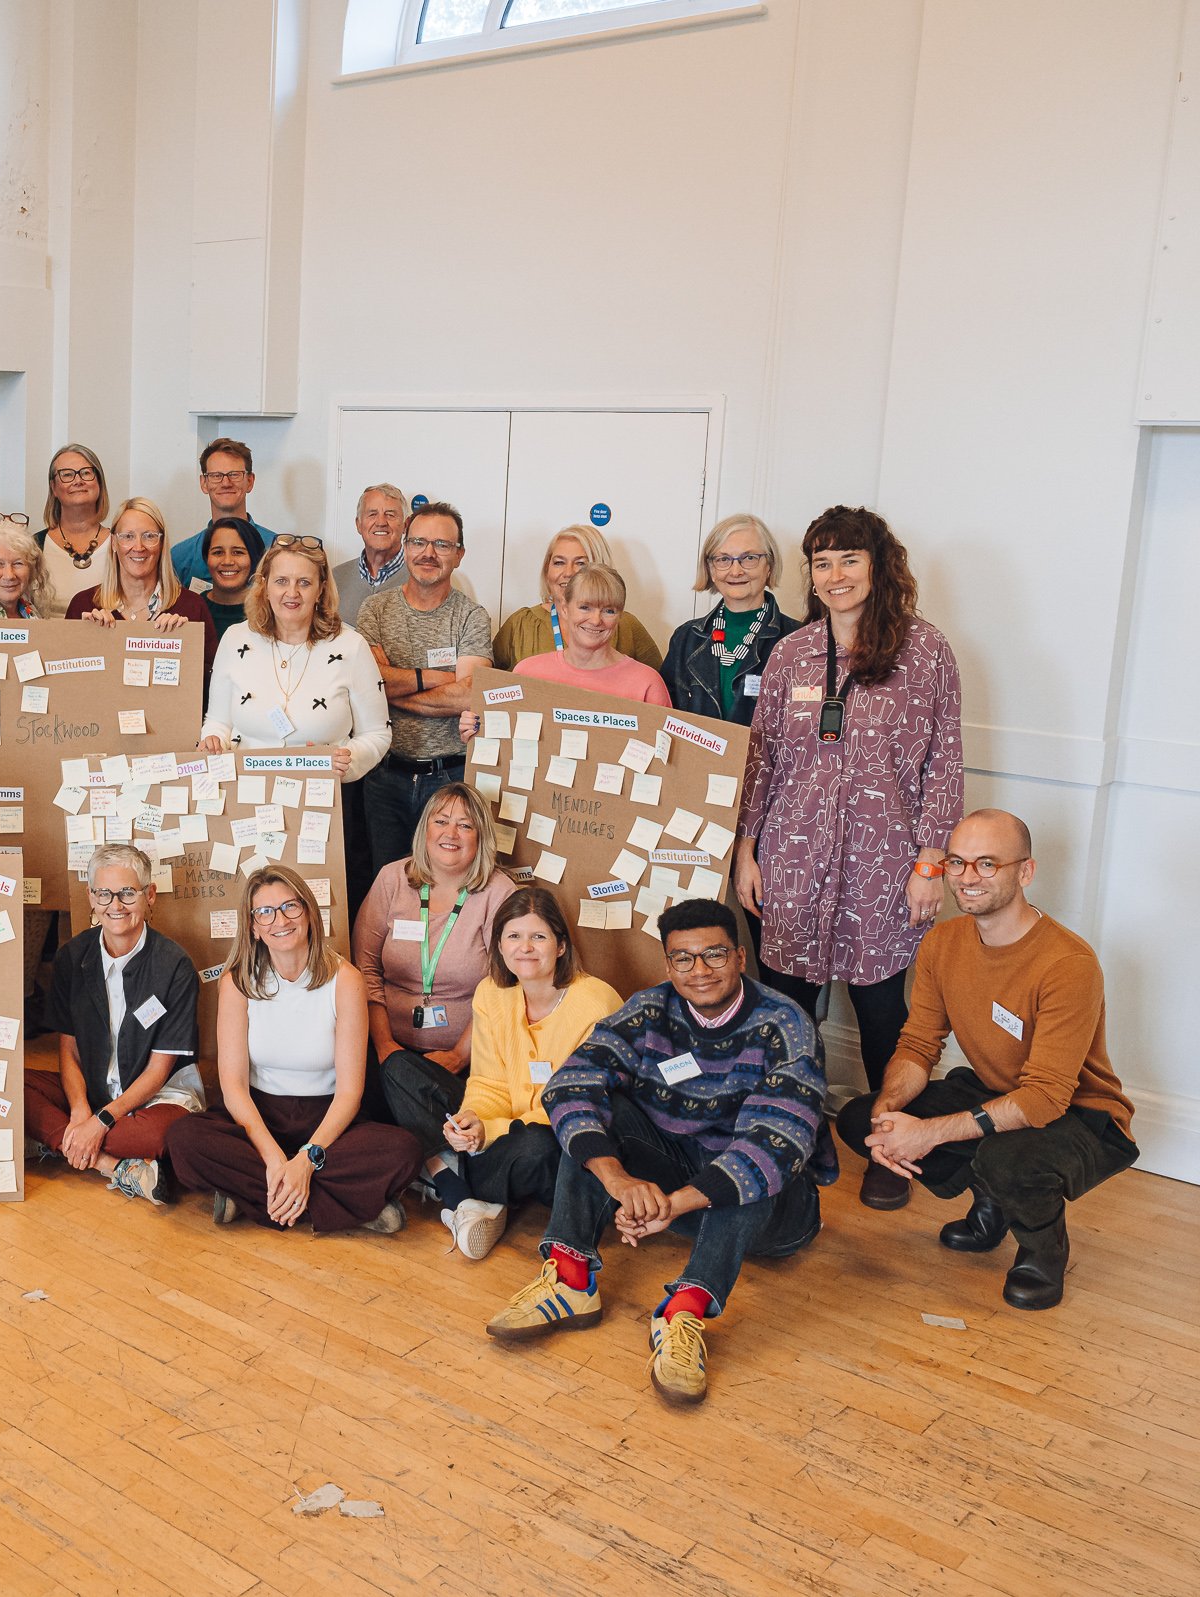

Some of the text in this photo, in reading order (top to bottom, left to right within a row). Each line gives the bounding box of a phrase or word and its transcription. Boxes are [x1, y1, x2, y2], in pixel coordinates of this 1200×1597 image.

[128, 639, 180, 650] Individuals
[47, 658, 102, 672] Institutions
[488, 689, 521, 701] Groups
[555, 710, 636, 727] Spaces & Places
[666, 720, 721, 752] Individuals
[177, 763, 204, 775] Other
[245, 757, 330, 768] Spaces & Places
[551, 791, 602, 815] MENDIP
[556, 815, 616, 840] VILLAGES
[651, 851, 709, 863] Institutions
[174, 884, 226, 900] ELDERS
[591, 882, 626, 896] Stories
[203, 964, 225, 979] Stor
